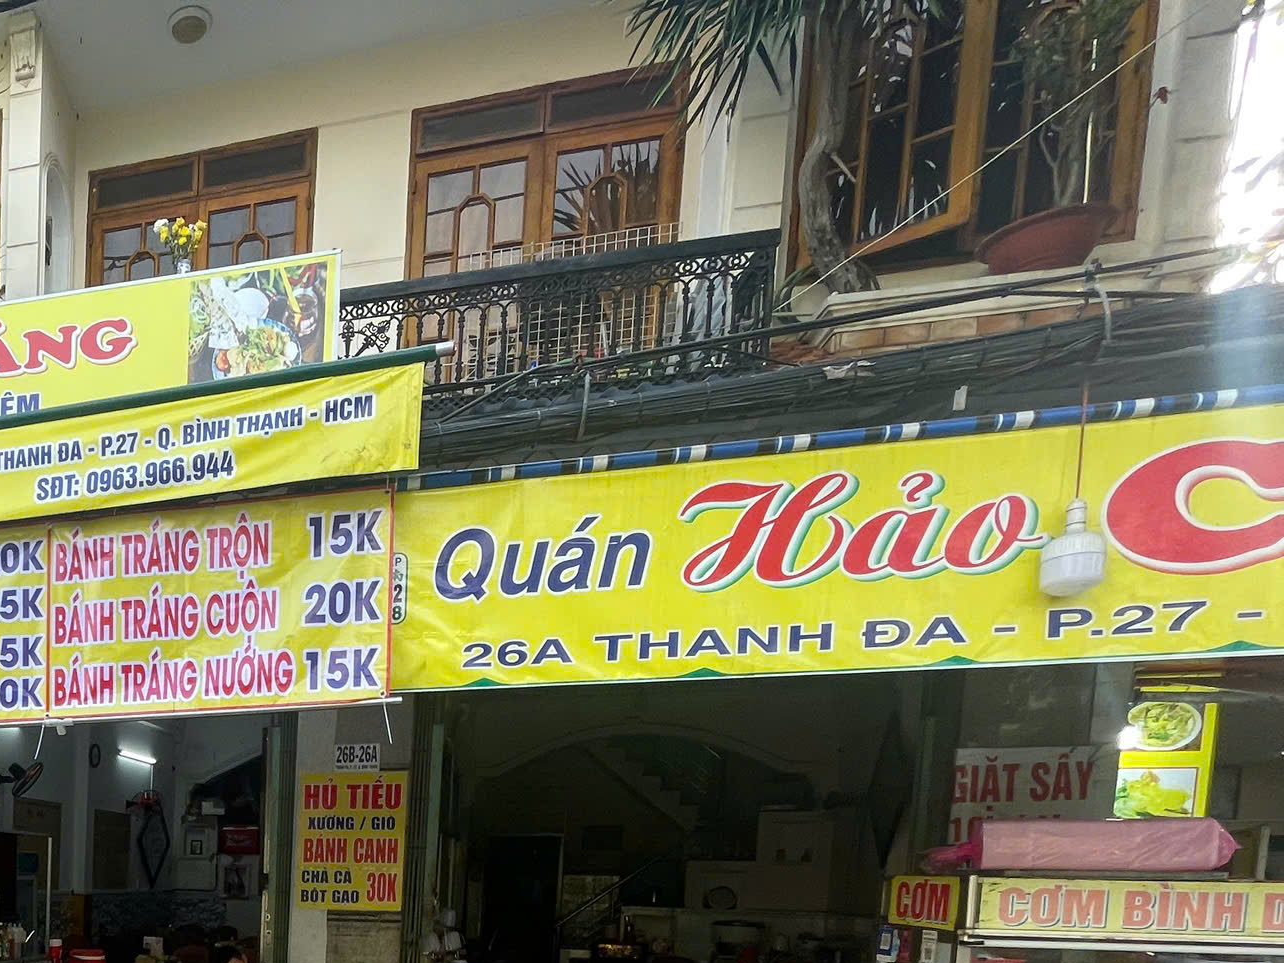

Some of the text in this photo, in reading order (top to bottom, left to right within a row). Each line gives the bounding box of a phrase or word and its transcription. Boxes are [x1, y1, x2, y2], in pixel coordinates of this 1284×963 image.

[57, 442, 82, 463] ĐA
[101, 431, 138, 457] P.27
[157, 430, 176, 452] Q.
[182, 414, 230, 446] BÌNH
[236, 408, 304, 437] THẠNH
[324, 394, 374, 424] HCM
[35, 450, 234, 502] SĐT: 0963.966.944
[54, 511, 383, 583] BÁNH TRÁNG TRỘN 15K
[435, 515, 651, 602] Quán
[678, 471, 1048, 592] Hảo
[54, 579, 381, 646] BÁNH TRÁNG CUỘN 20K
[462, 637, 573, 669] 26A
[594, 622, 834, 663] THANH
[863, 616, 967, 649] ĐA
[1047, 600, 1208, 639] P.27
[53, 644, 380, 707] BÁNH TRÁNG NƯỚNG 15K
[336, 745, 378, 764] 26B-26A
[1029, 750, 1096, 803] SẤY
[303, 775, 402, 810] HỦ TIẾU
[302, 834, 399, 865] BÁNH CANH
[331, 889, 360, 906] GẠO
[366, 871, 398, 903] 30K
[896, 878, 951, 924] CƠM
[998, 884, 1109, 930] CƠM
[1122, 883, 1248, 933] BÌNH
